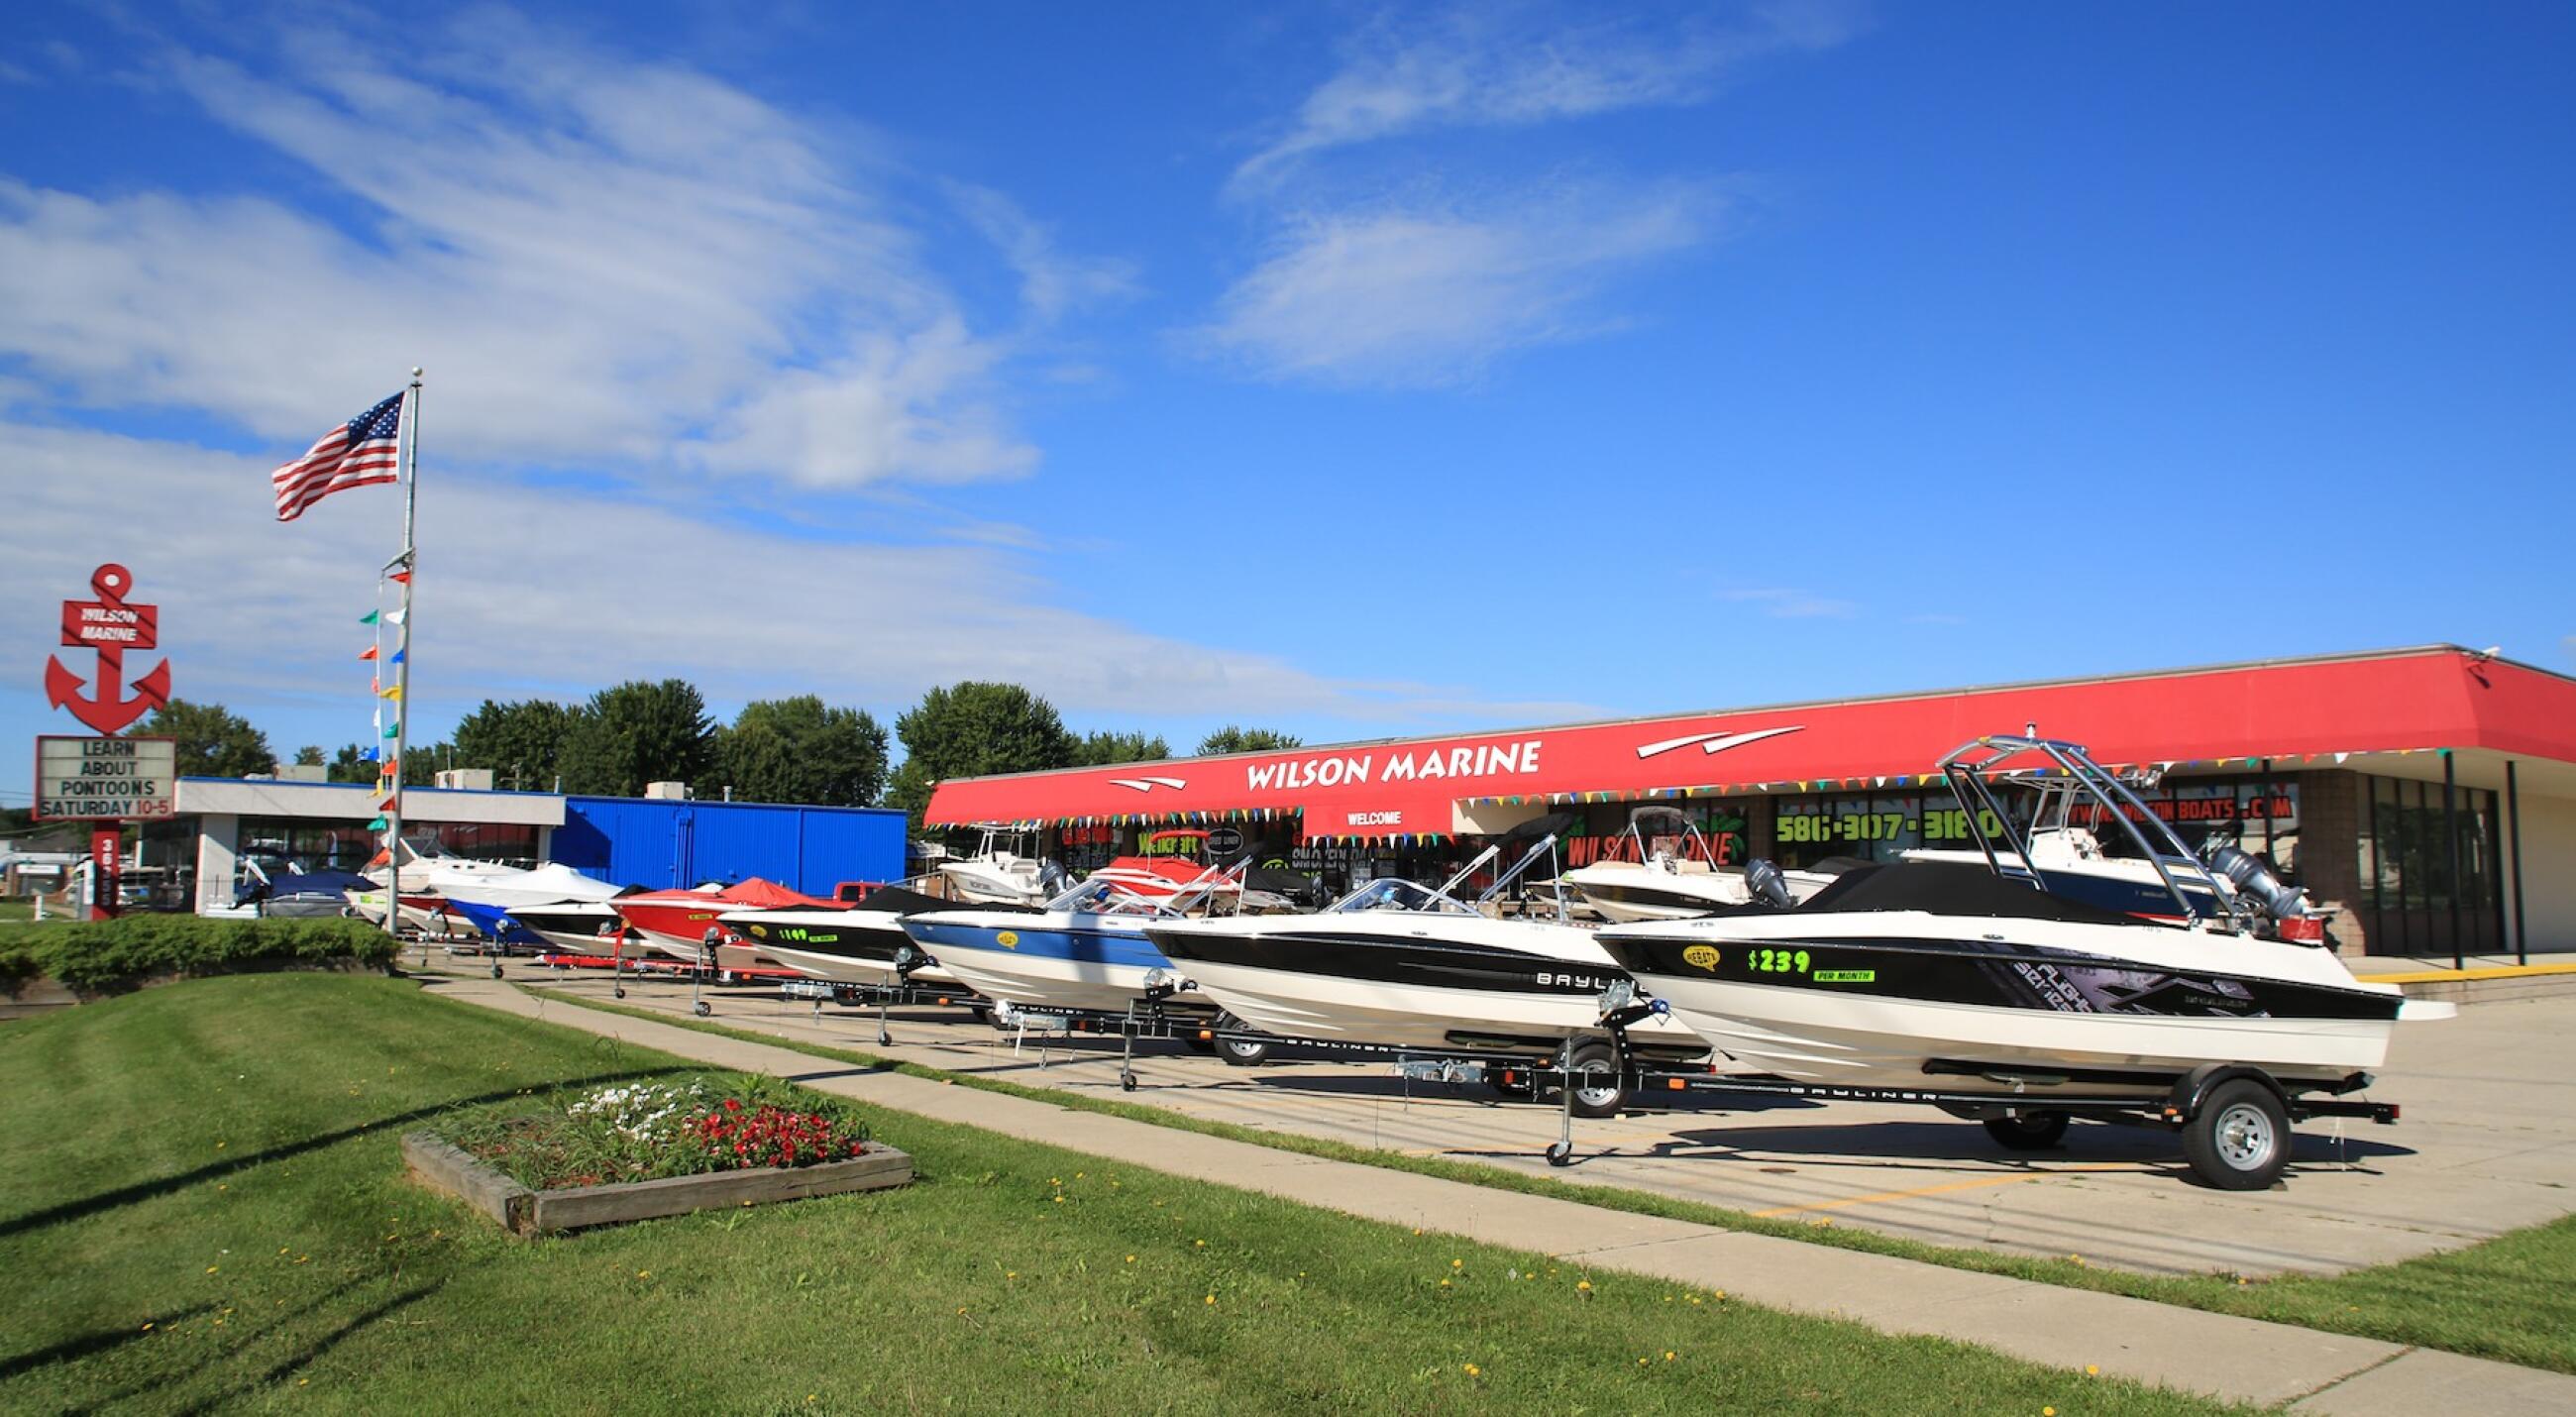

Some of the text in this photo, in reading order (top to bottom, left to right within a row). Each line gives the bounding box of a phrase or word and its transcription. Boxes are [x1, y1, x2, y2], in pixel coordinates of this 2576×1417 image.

[81, 607, 138, 623] WILSON
[81, 627, 137, 641] MARINE
[83, 742, 134, 756] LEARN
[81, 762, 137, 776] ABOUT
[1246, 741, 1542, 792] WILSON MARINE
[61, 781, 155, 796] PONTOONS
[40, 800, 168, 816] SATURDAY 10-5
[1347, 812, 1402, 825] WELCOME
[1749, 949, 1810, 973] $239
[1789, 1087, 1937, 1100] BAYLINER
